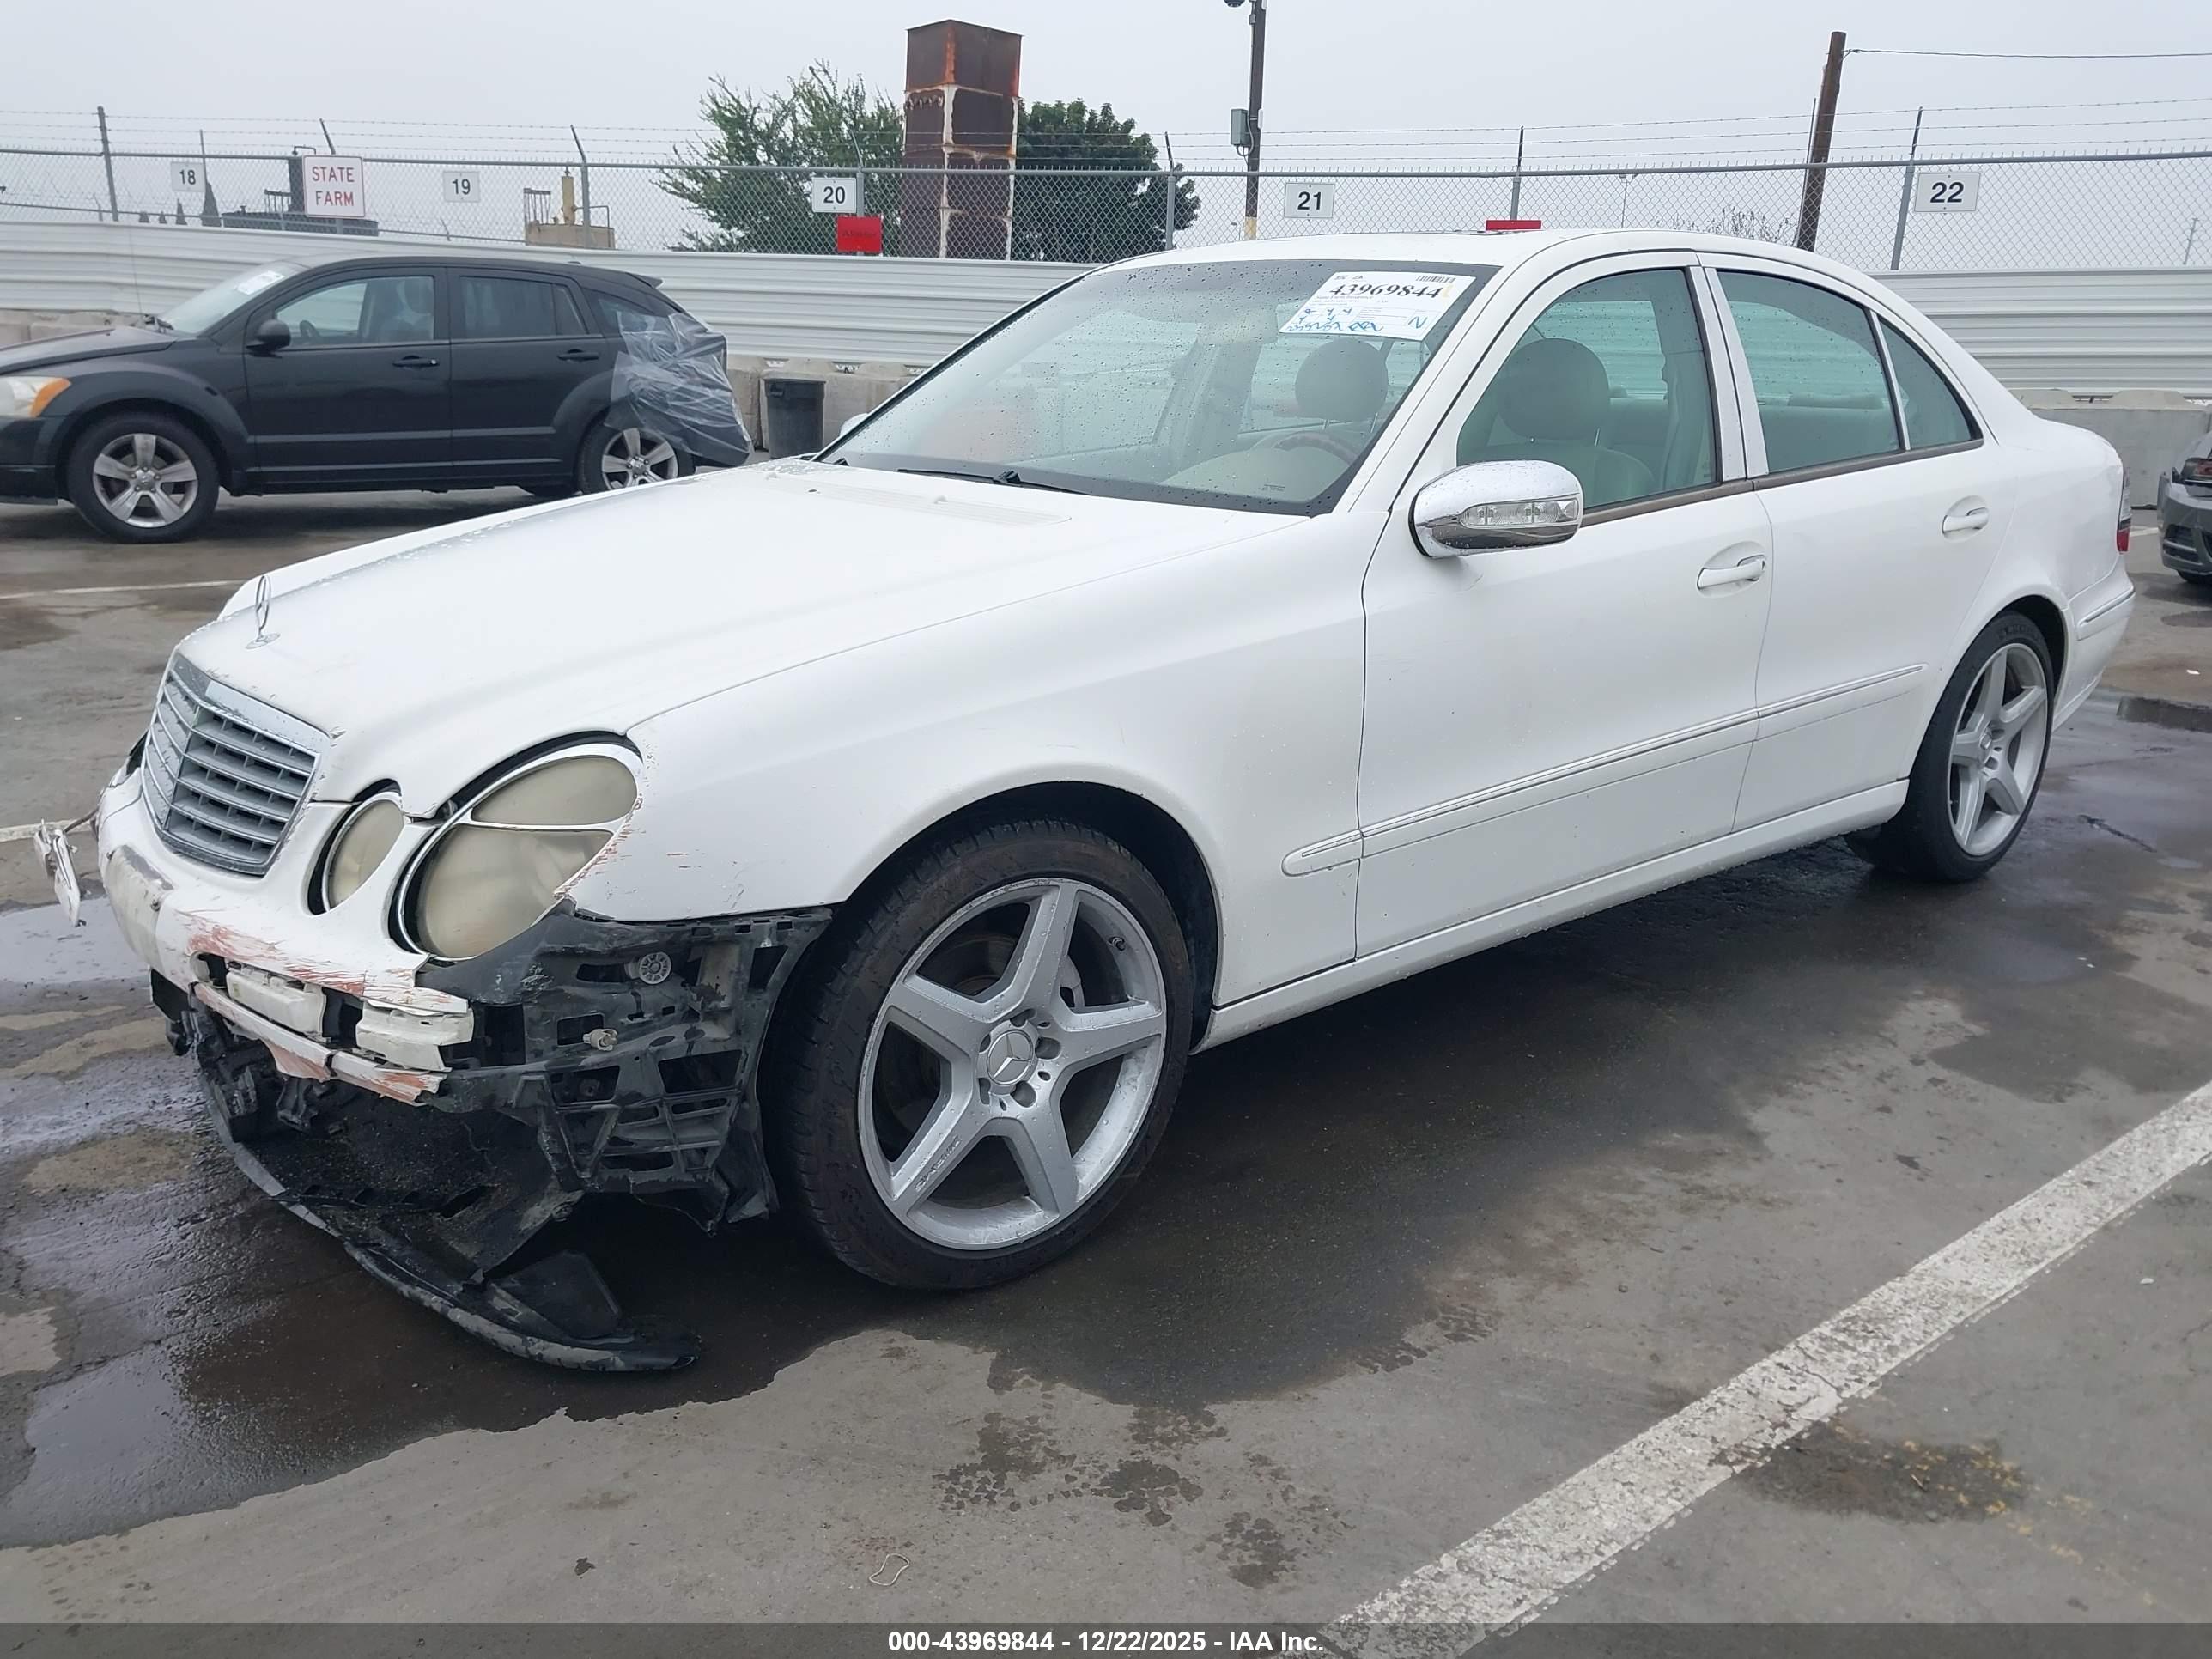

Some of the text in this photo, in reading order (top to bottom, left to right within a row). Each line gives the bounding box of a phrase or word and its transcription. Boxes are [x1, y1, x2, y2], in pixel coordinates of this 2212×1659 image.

[179, 169, 197, 185] 18
[312, 167, 355, 183] STATE
[452, 179, 471, 195] 19
[823, 185, 847, 205] 20
[1929, 181, 1965, 204] 22
[315, 191, 355, 207] FARM
[1297, 191, 1323, 211] 21
[1329, 283, 1443, 298] 43969844
